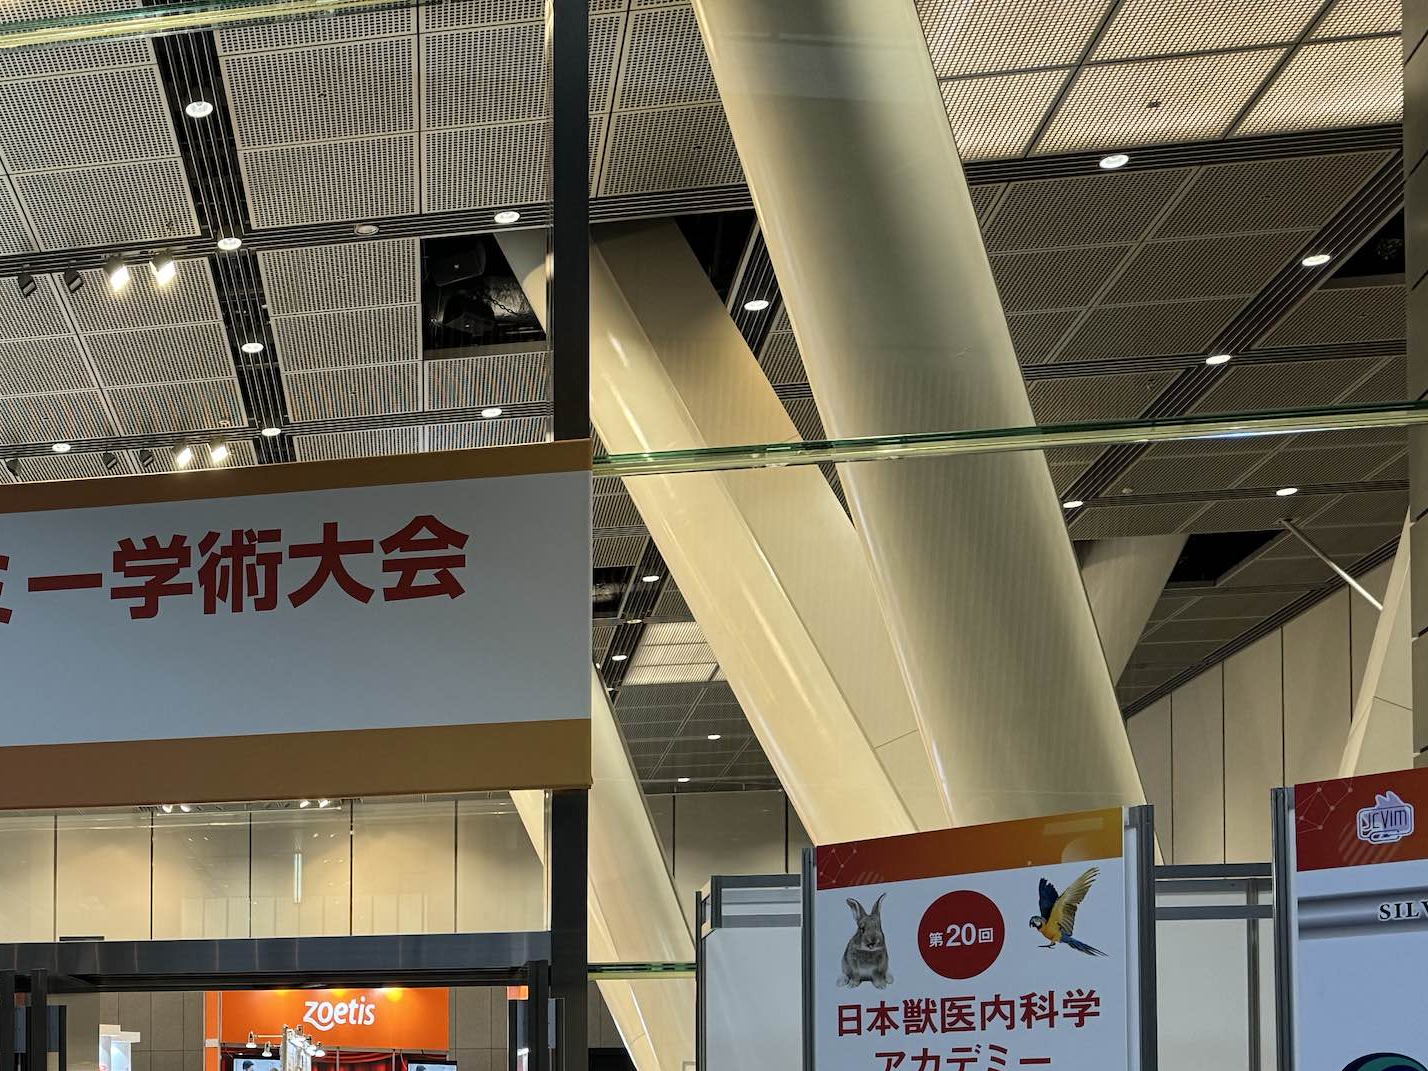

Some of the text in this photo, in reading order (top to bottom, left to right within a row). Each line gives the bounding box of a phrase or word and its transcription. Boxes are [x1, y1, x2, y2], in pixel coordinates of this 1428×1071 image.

[929, 922, 994, 948] 第20回
[303, 996, 376, 1031] zoetis
[838, 988, 1100, 1036] 日本獣医内科学
